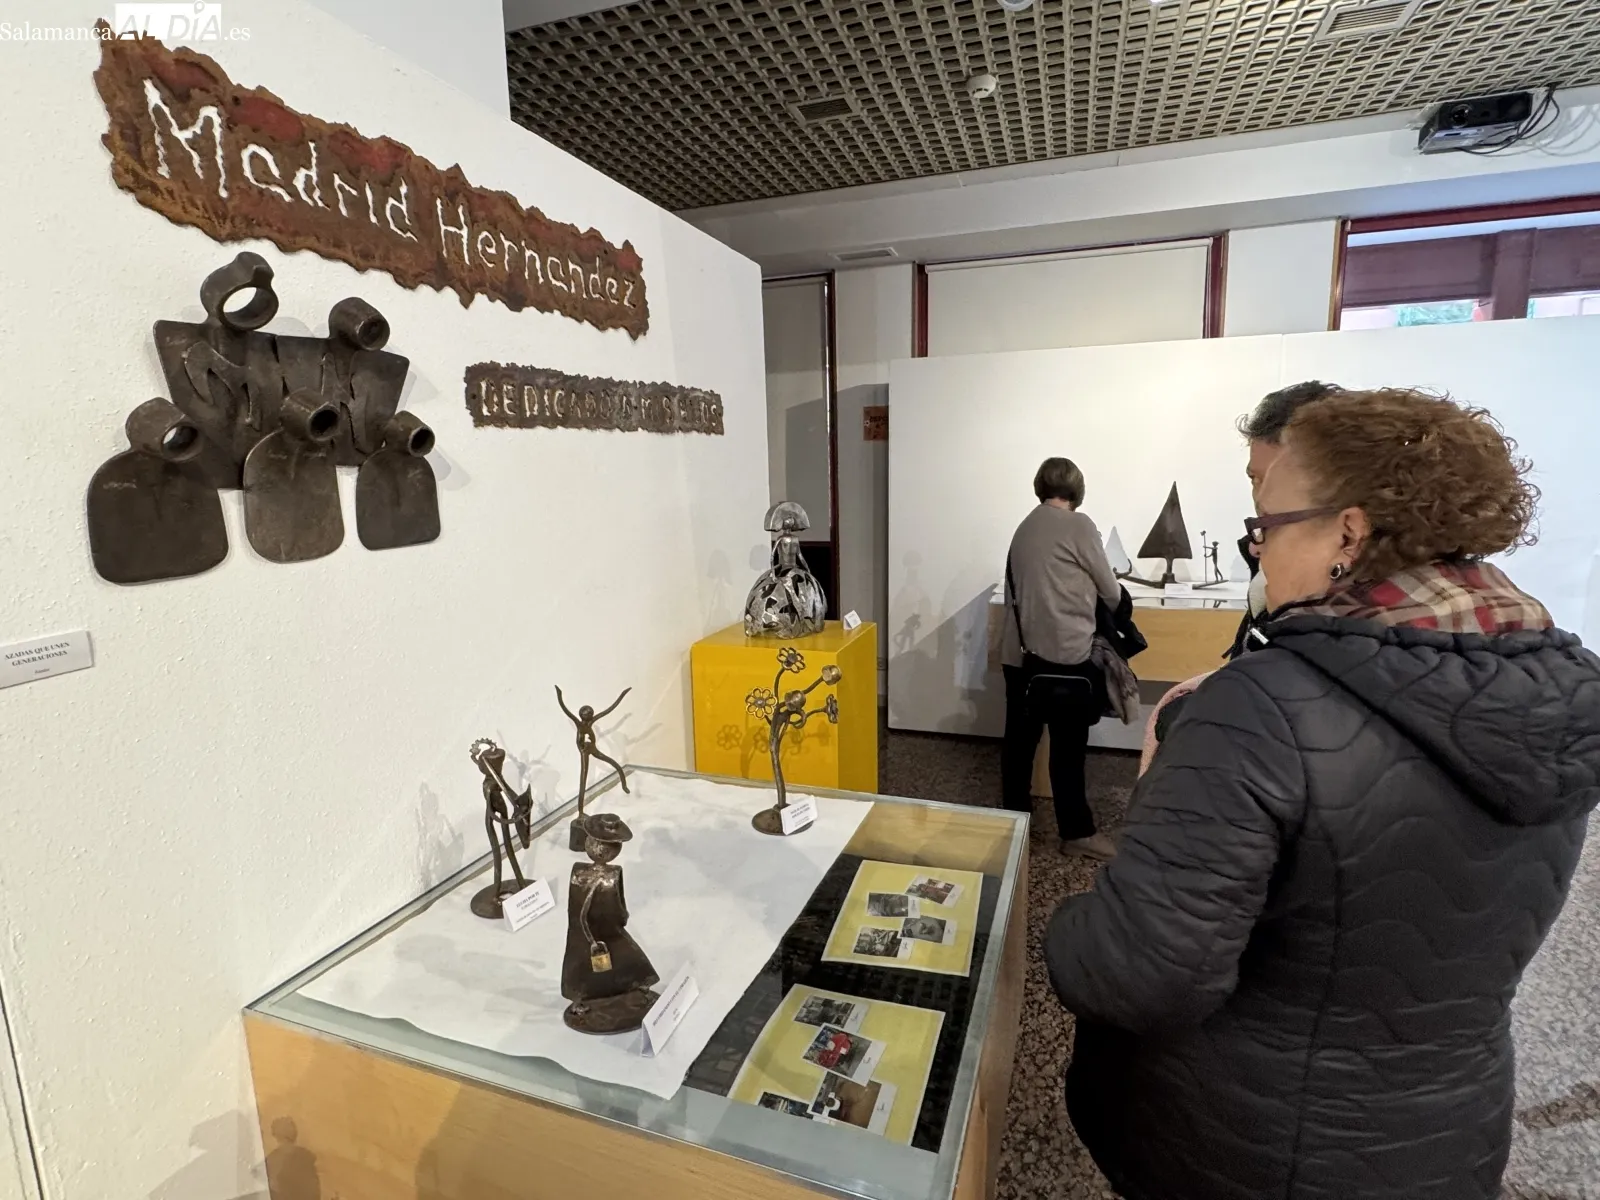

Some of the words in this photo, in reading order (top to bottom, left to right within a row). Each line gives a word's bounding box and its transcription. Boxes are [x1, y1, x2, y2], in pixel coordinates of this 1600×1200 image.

[143, 78, 418, 242] Madrid
[437, 197, 637, 309] Hernandez
[5, 649, 33, 660] AZADAS
[34, 645, 50, 655] QUE
[11, 650, 68, 667] GENERACIONES
